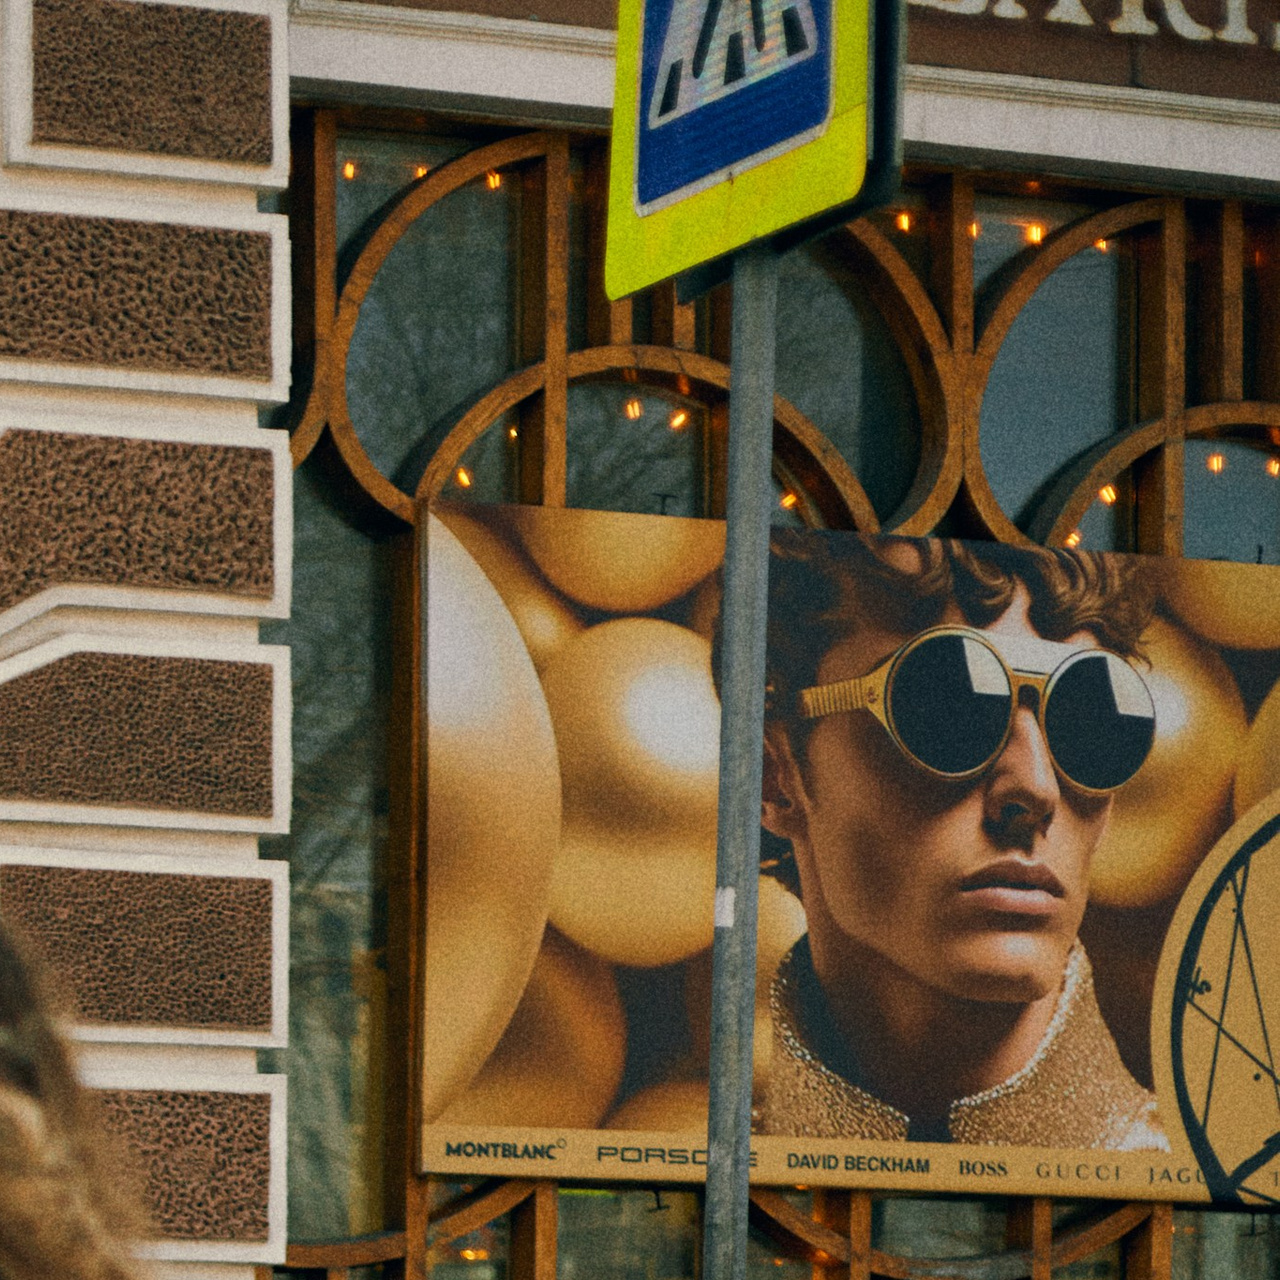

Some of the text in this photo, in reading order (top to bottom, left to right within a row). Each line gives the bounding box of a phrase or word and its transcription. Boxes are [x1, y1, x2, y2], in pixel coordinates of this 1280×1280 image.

[445, 1141, 557, 1160] MONTBLANC
[597, 1146, 758, 1167] PORSC
[787, 1153, 838, 1170] DAVID
[844, 1155, 930, 1173] BECKHAM
[959, 1160, 1008, 1177] BOSS
[1036, 1162, 1120, 1181] GUCCI
